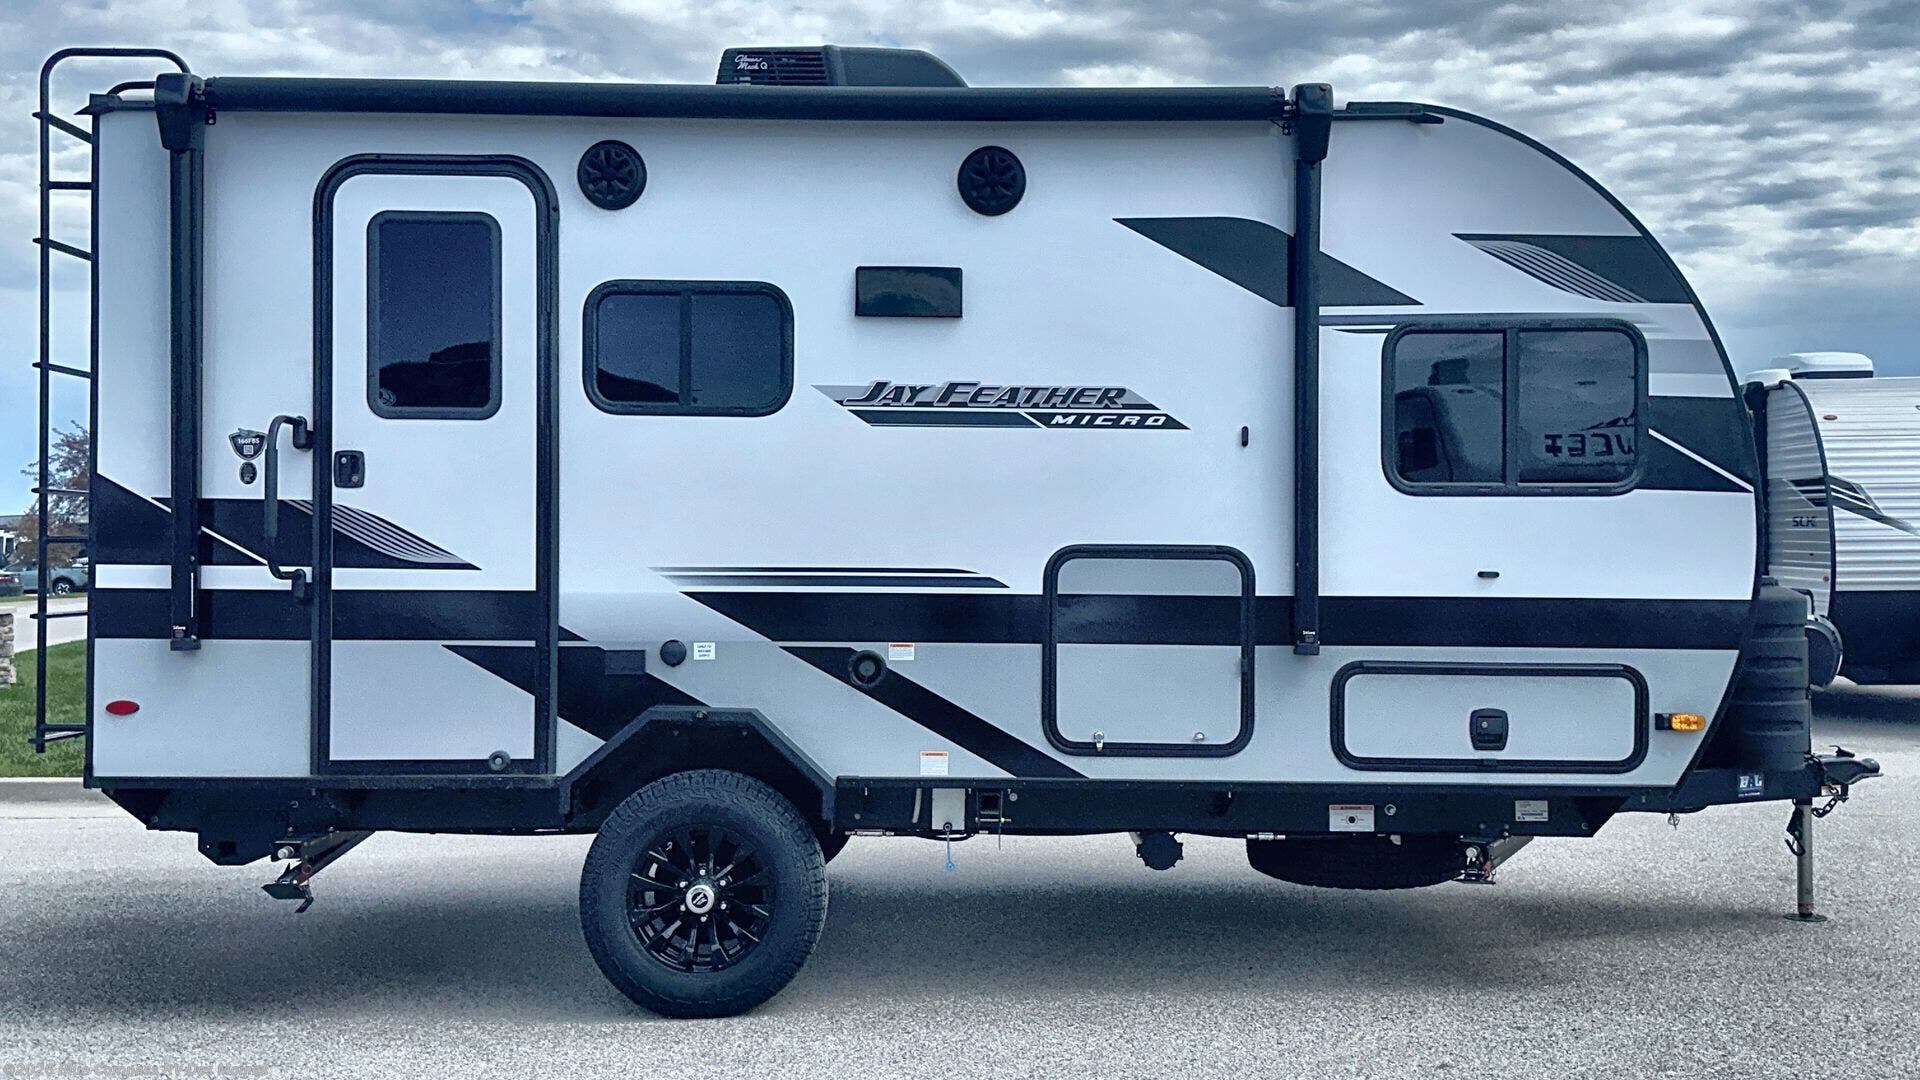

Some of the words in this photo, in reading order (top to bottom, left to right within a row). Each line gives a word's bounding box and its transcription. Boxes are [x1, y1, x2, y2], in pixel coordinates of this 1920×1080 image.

[843, 380, 932, 407] JAY
[934, 380, 1127, 408] FEATHER
[1050, 414, 1167, 426] MICRO
